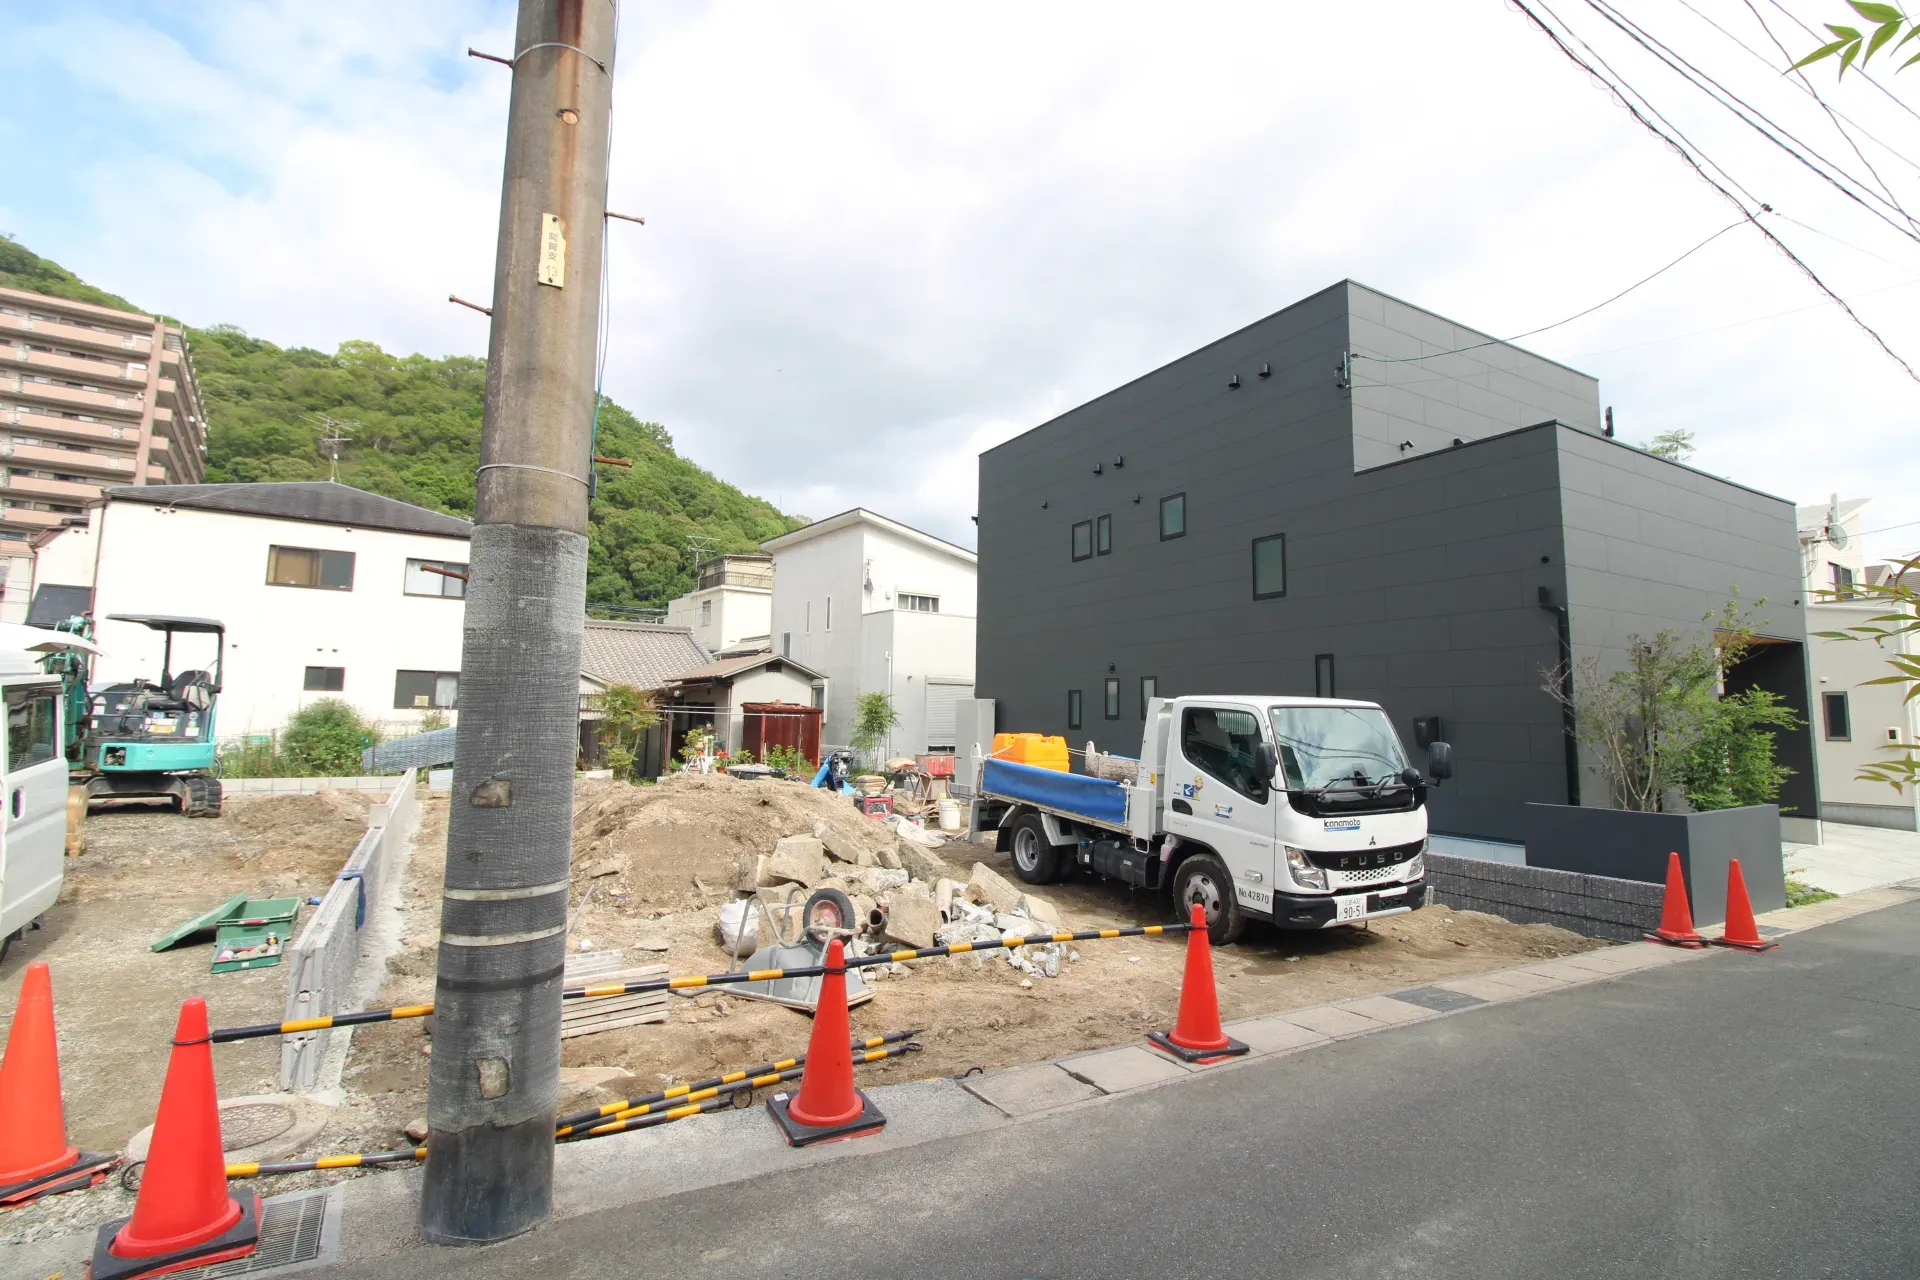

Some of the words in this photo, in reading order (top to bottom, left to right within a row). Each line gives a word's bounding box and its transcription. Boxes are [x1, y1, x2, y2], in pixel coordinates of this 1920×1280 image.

[1324, 818, 1360, 827] kanamoto
[1340, 852, 1402, 867] FUSO
[1344, 905, 1364, 919] 90-51
